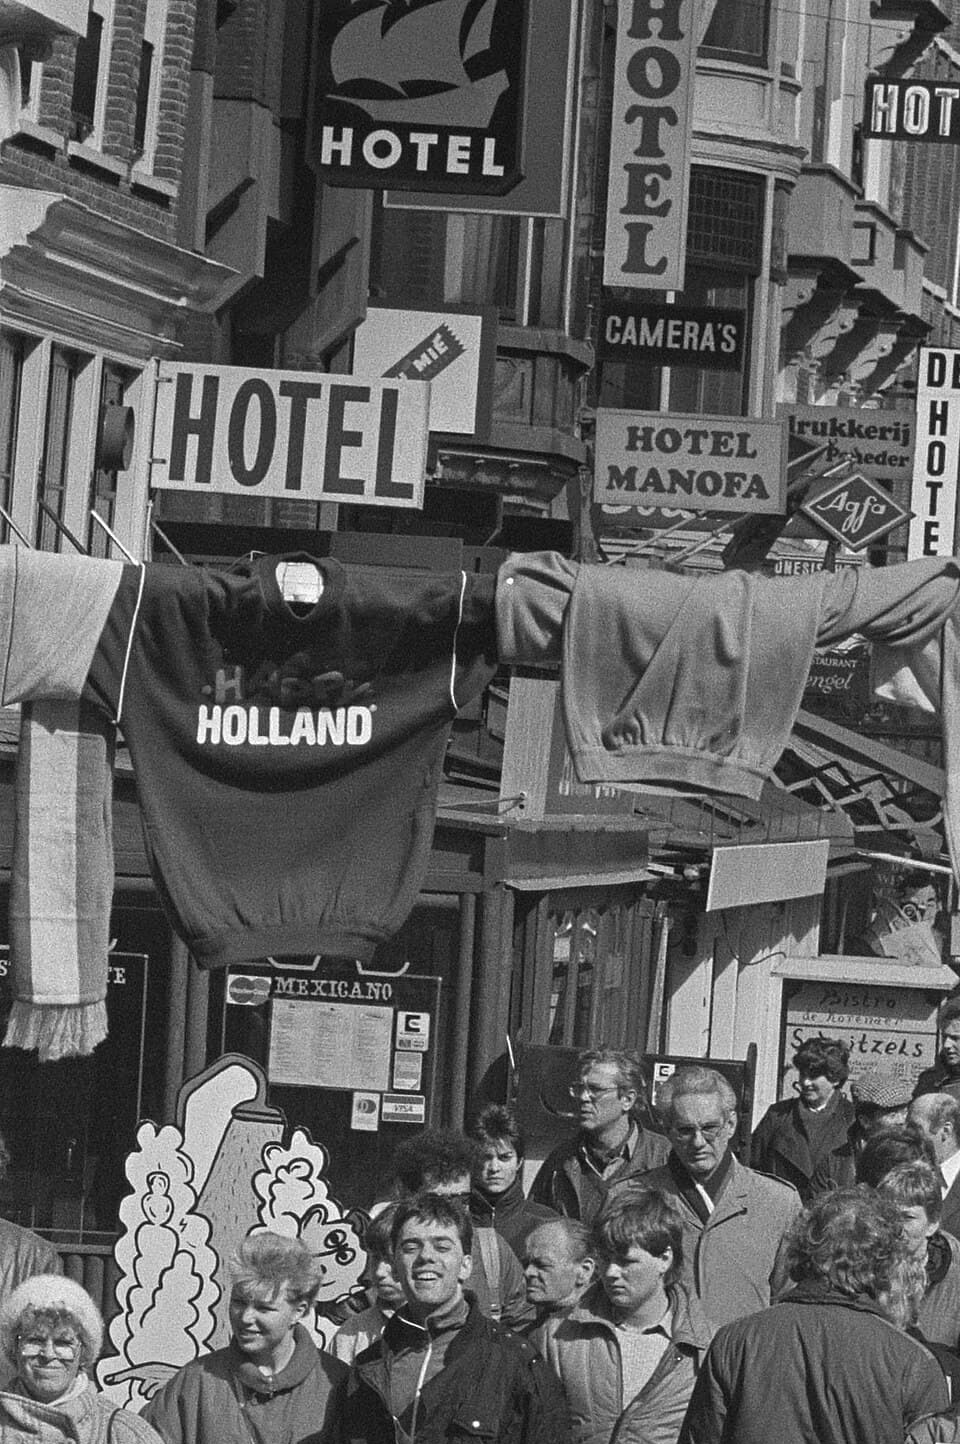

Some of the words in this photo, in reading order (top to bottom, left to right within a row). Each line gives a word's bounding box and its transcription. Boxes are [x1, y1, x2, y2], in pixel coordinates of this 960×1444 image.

[319, 126, 505, 177] HOTEL
[619, 0, 687, 276] HOTEL
[605, 315, 738, 353] CAMERA'S
[167, 372, 415, 499] HOTEL
[625, 426, 758, 460] HOTEL
[605, 464, 771, 501] MANOFA
[816, 491, 887, 534] Agfa
[196, 704, 373, 746] HOLLAND
[273, 976, 393, 1001] MEXICANO
